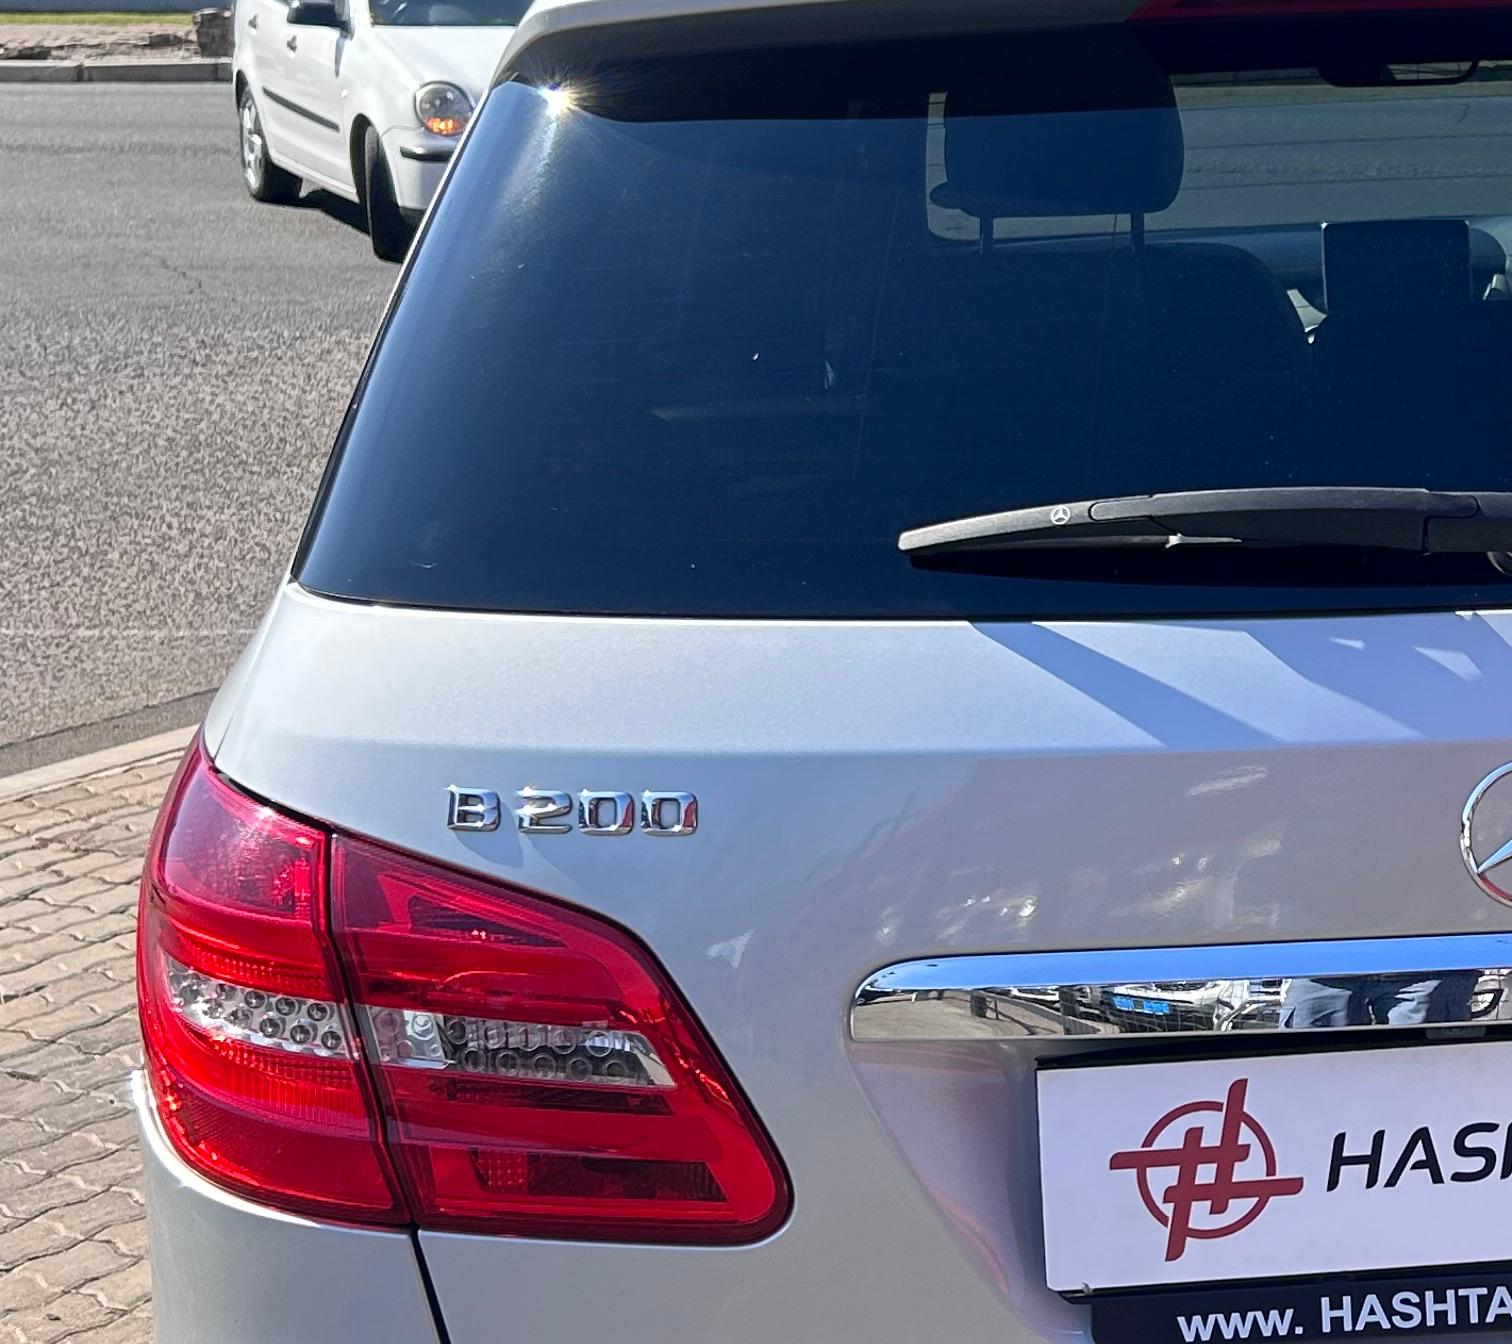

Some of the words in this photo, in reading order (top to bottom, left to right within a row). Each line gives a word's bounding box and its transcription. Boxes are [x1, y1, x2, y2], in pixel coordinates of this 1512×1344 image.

[446, 785, 501, 832] B
[516, 786, 699, 836] 200
[1177, 1308, 1304, 1343] www.
